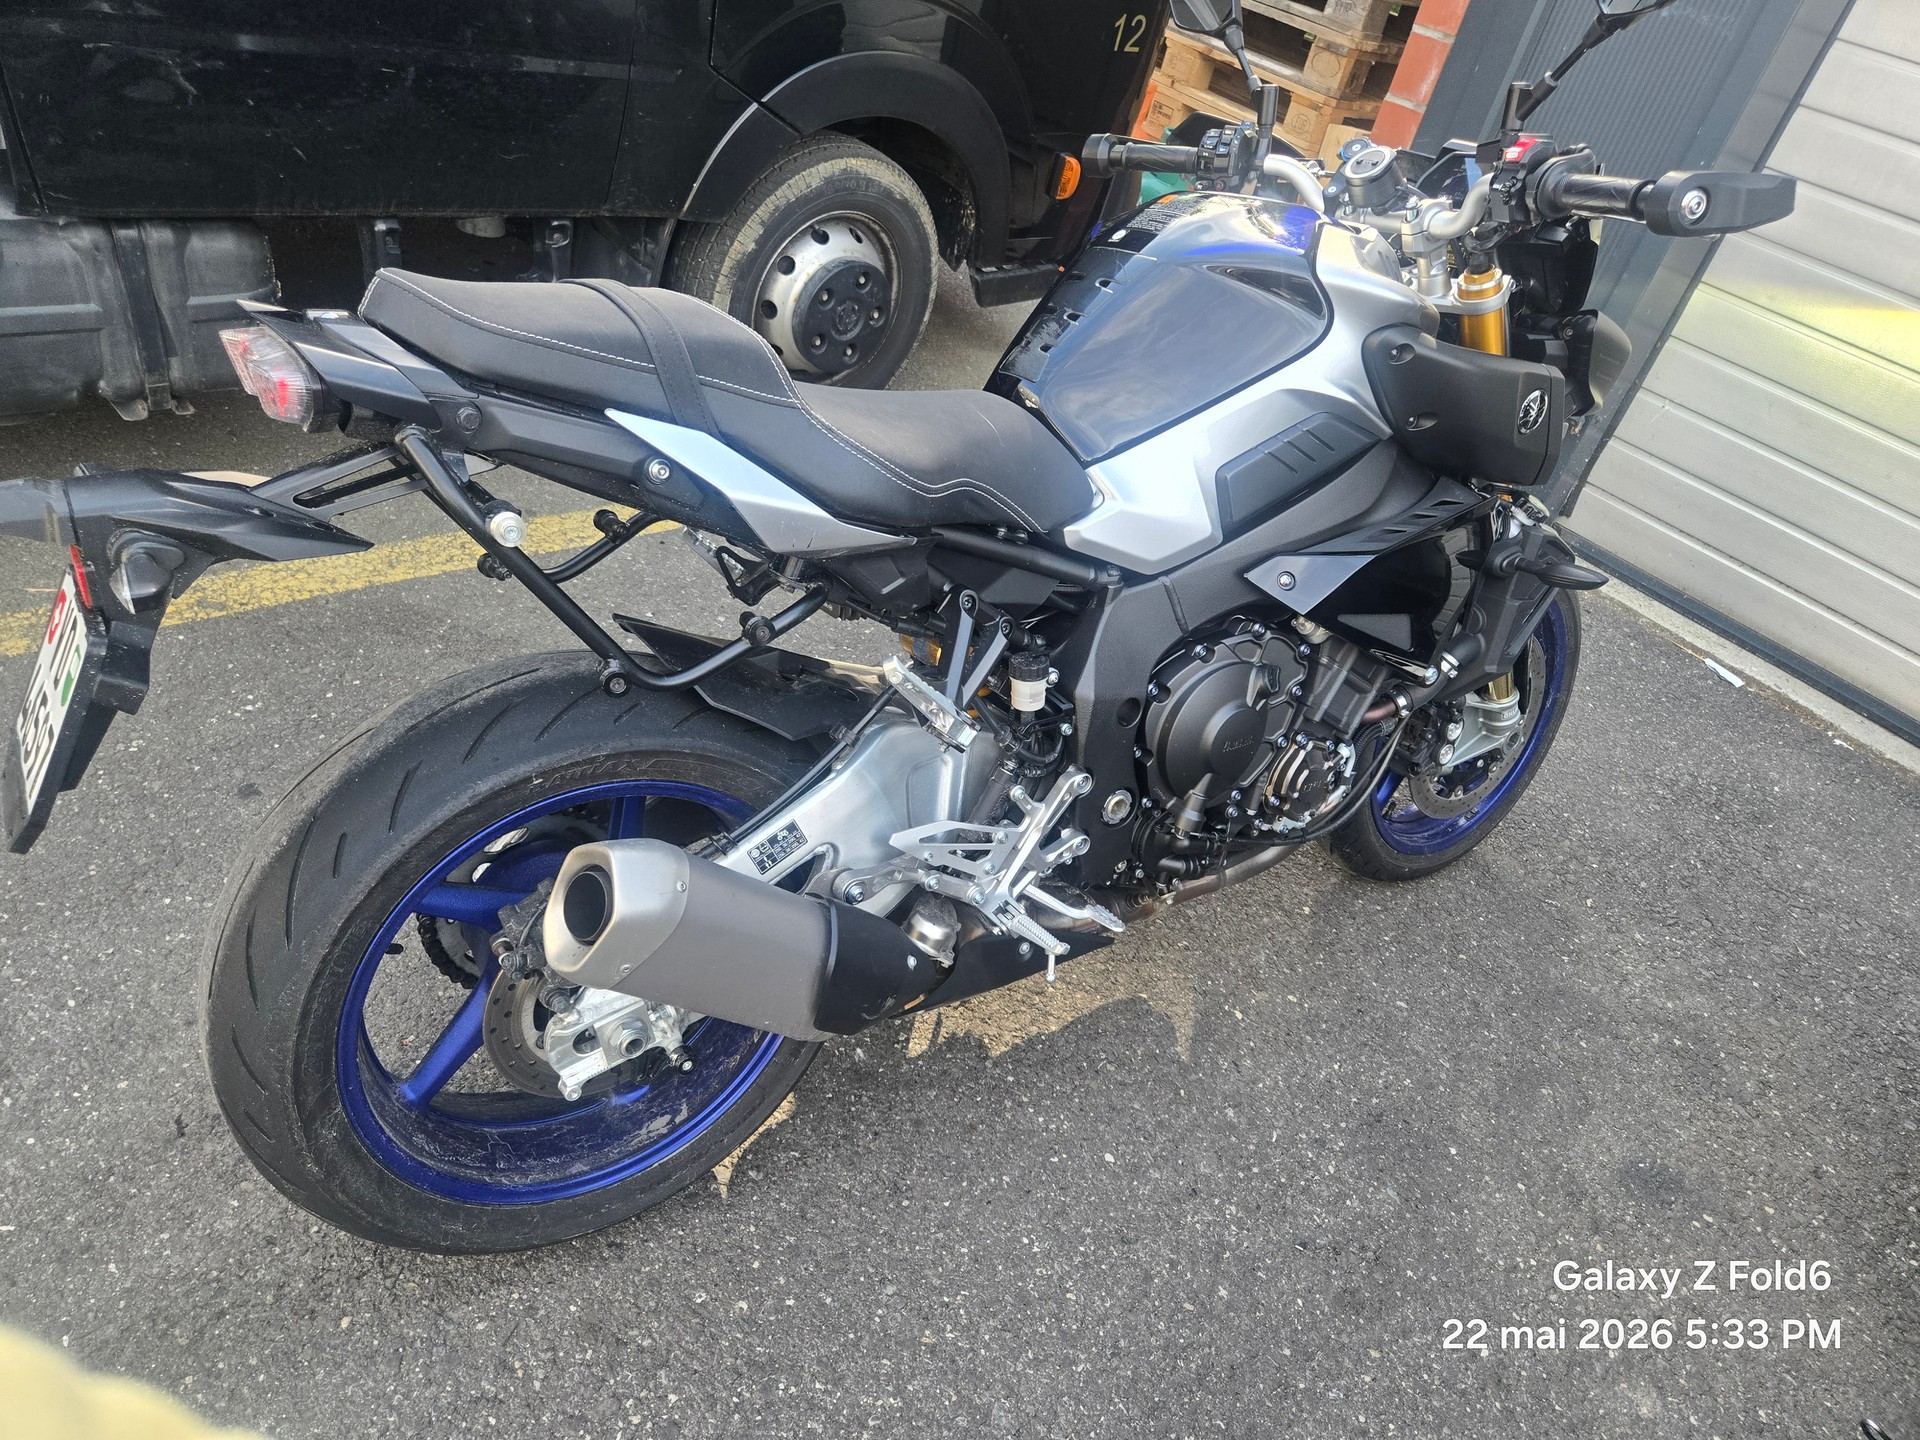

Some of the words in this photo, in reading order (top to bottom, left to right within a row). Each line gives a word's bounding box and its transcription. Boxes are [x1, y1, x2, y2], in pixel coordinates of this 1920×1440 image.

[1113, 13, 1147, 53] 12
[50, 606, 79, 692] VD
[20, 662, 55, 801] 46597
